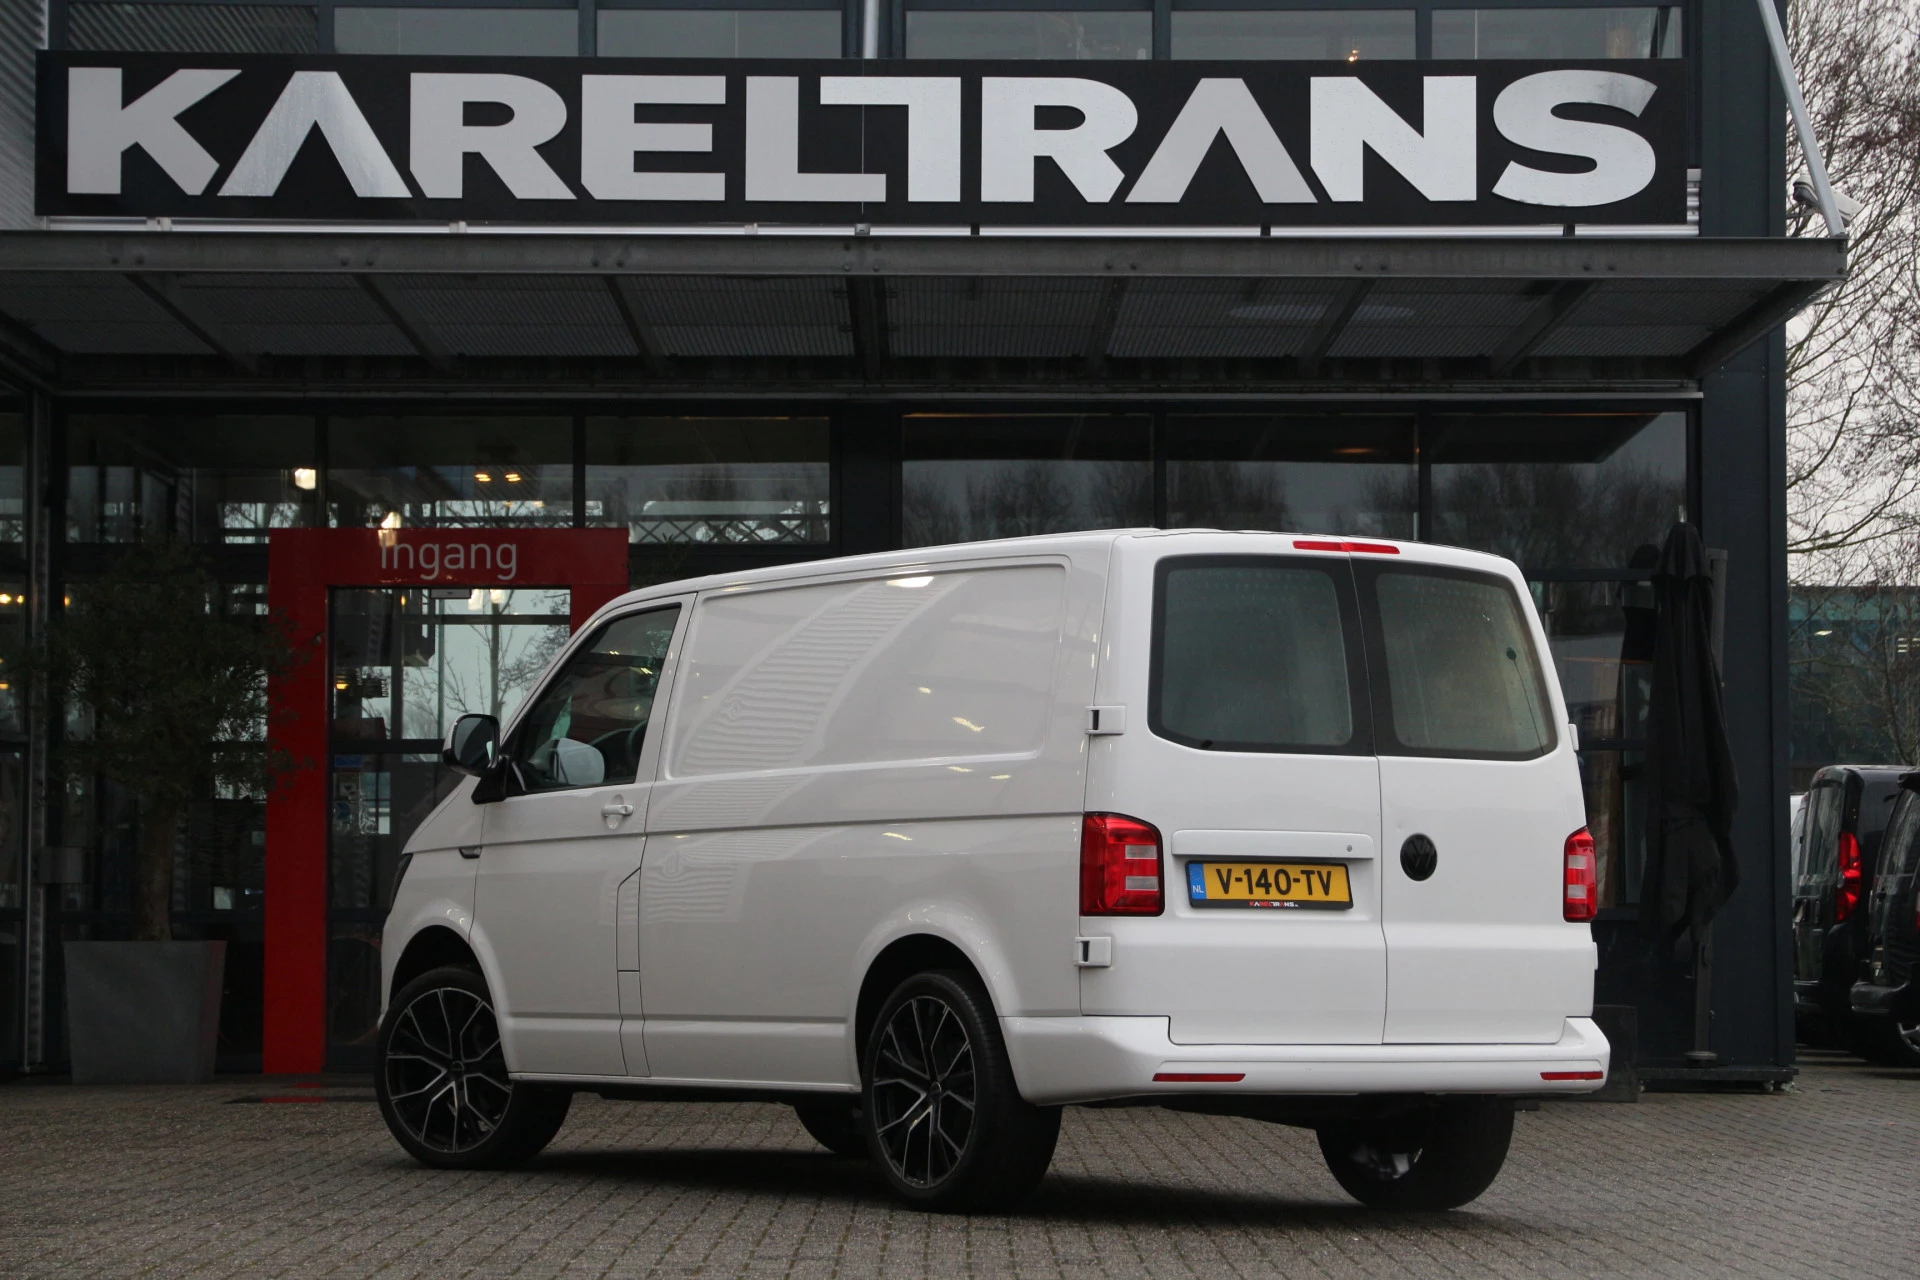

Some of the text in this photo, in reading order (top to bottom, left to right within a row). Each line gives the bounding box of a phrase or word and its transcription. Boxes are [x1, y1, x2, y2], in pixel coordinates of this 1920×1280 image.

[67, 66, 1658, 208] KARELTRANS
[380, 532, 518, 581] Ingang
[1192, 884, 1205, 894] NL
[1215, 868, 1333, 896] V-140-TV
